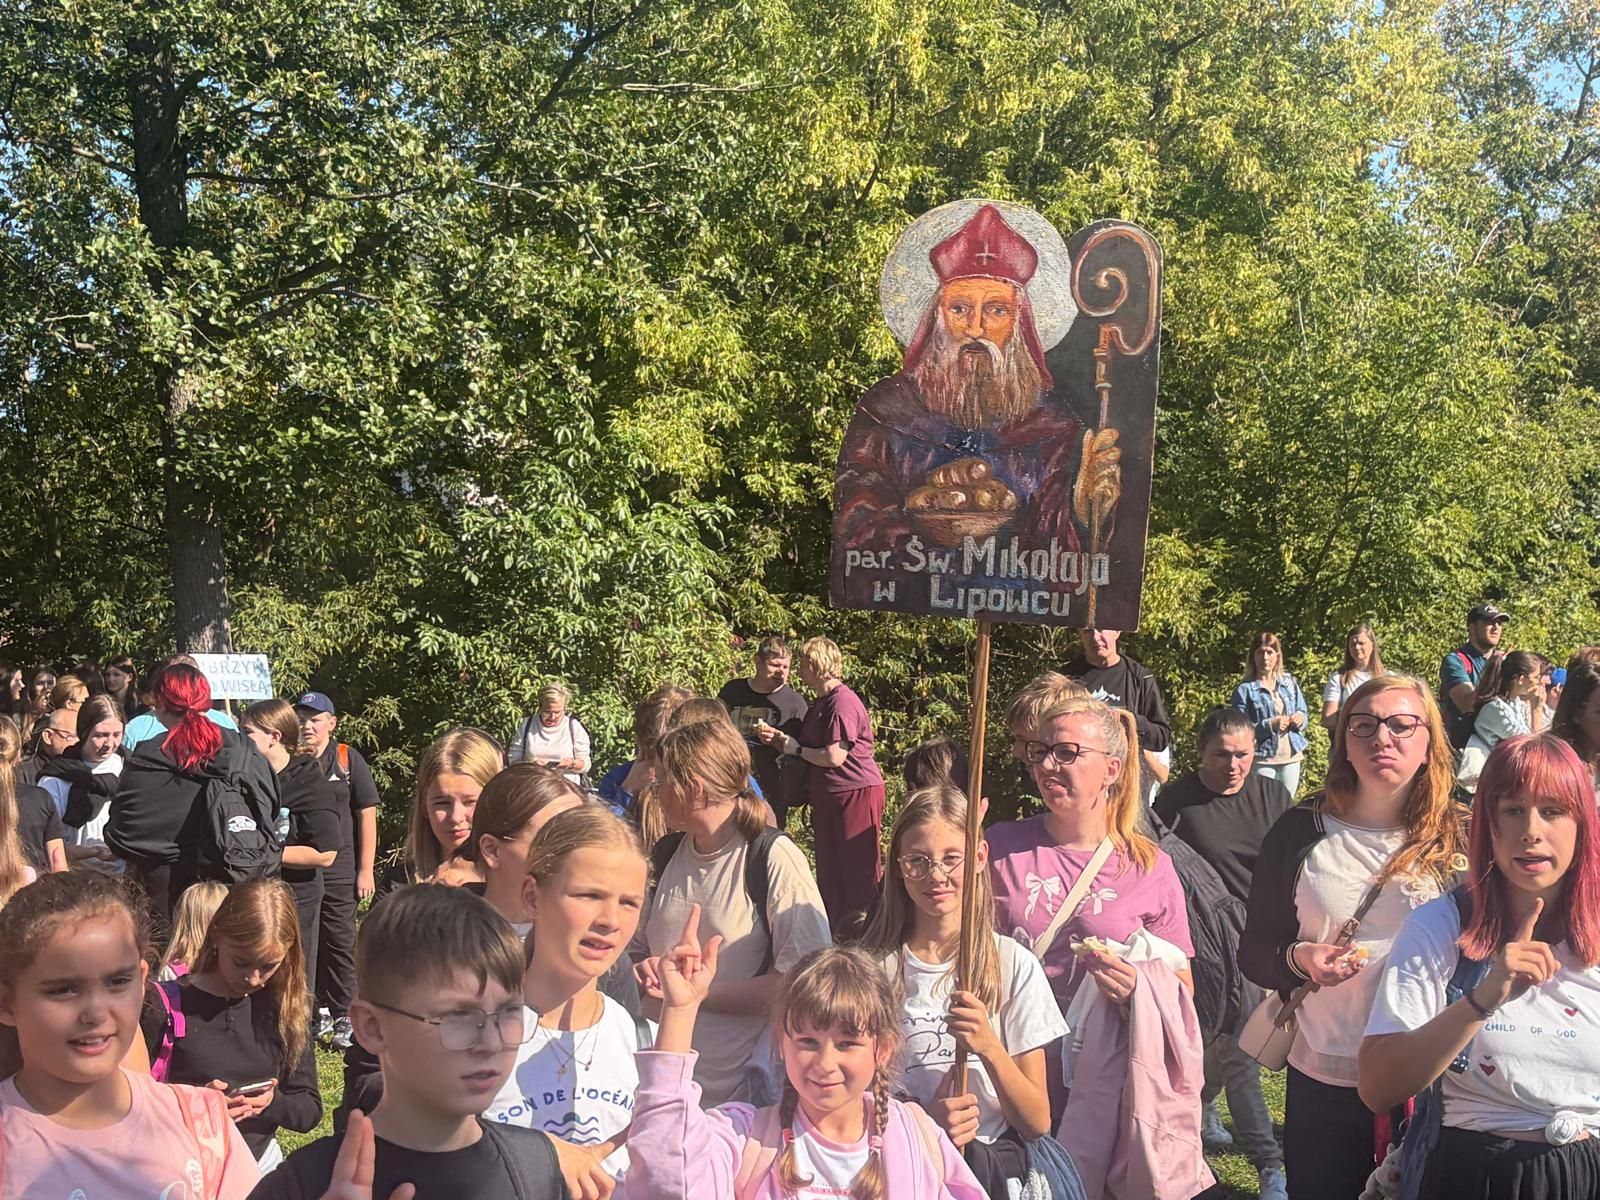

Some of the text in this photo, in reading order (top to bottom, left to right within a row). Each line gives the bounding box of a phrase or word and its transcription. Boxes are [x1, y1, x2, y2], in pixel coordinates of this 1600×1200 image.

[845, 534, 1110, 596] par. Św. Mikołaja
[873, 574, 1071, 618] w Lipowcu
[1484, 1023, 1516, 1032] CHILD
[1530, 1026, 1543, 1035] OF
[542, 1089, 566, 1106] DE
